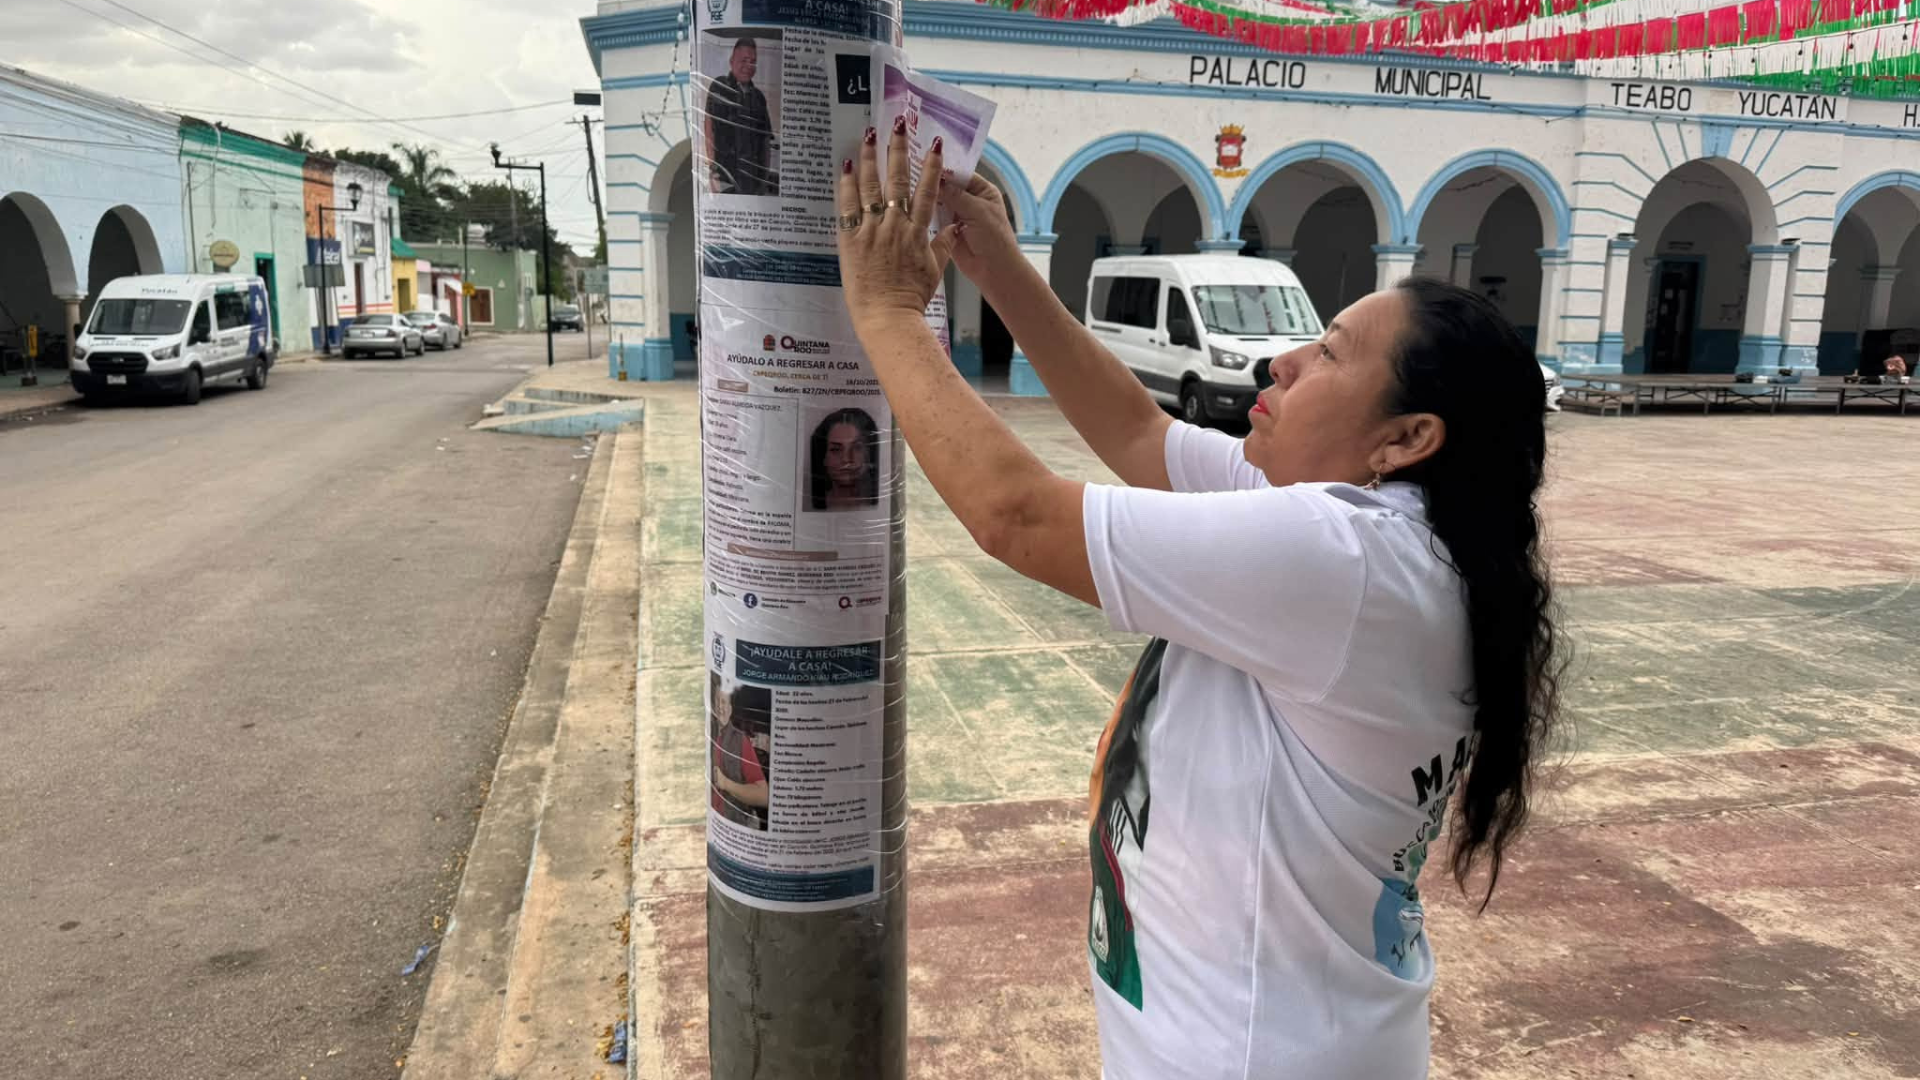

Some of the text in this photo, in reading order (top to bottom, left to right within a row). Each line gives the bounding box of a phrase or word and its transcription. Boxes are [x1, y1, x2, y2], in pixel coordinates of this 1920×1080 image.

[847, 75, 870, 94] ¿L
[1189, 55, 1307, 89] PALACIO
[1374, 66, 1492, 101] MUNICIPAL
[1611, 82, 1838, 120] TEABO YUCATÁN
[727, 353, 860, 371] AYÚDALO A REGRESAR A CASA
[788, 662, 796, 671] A
